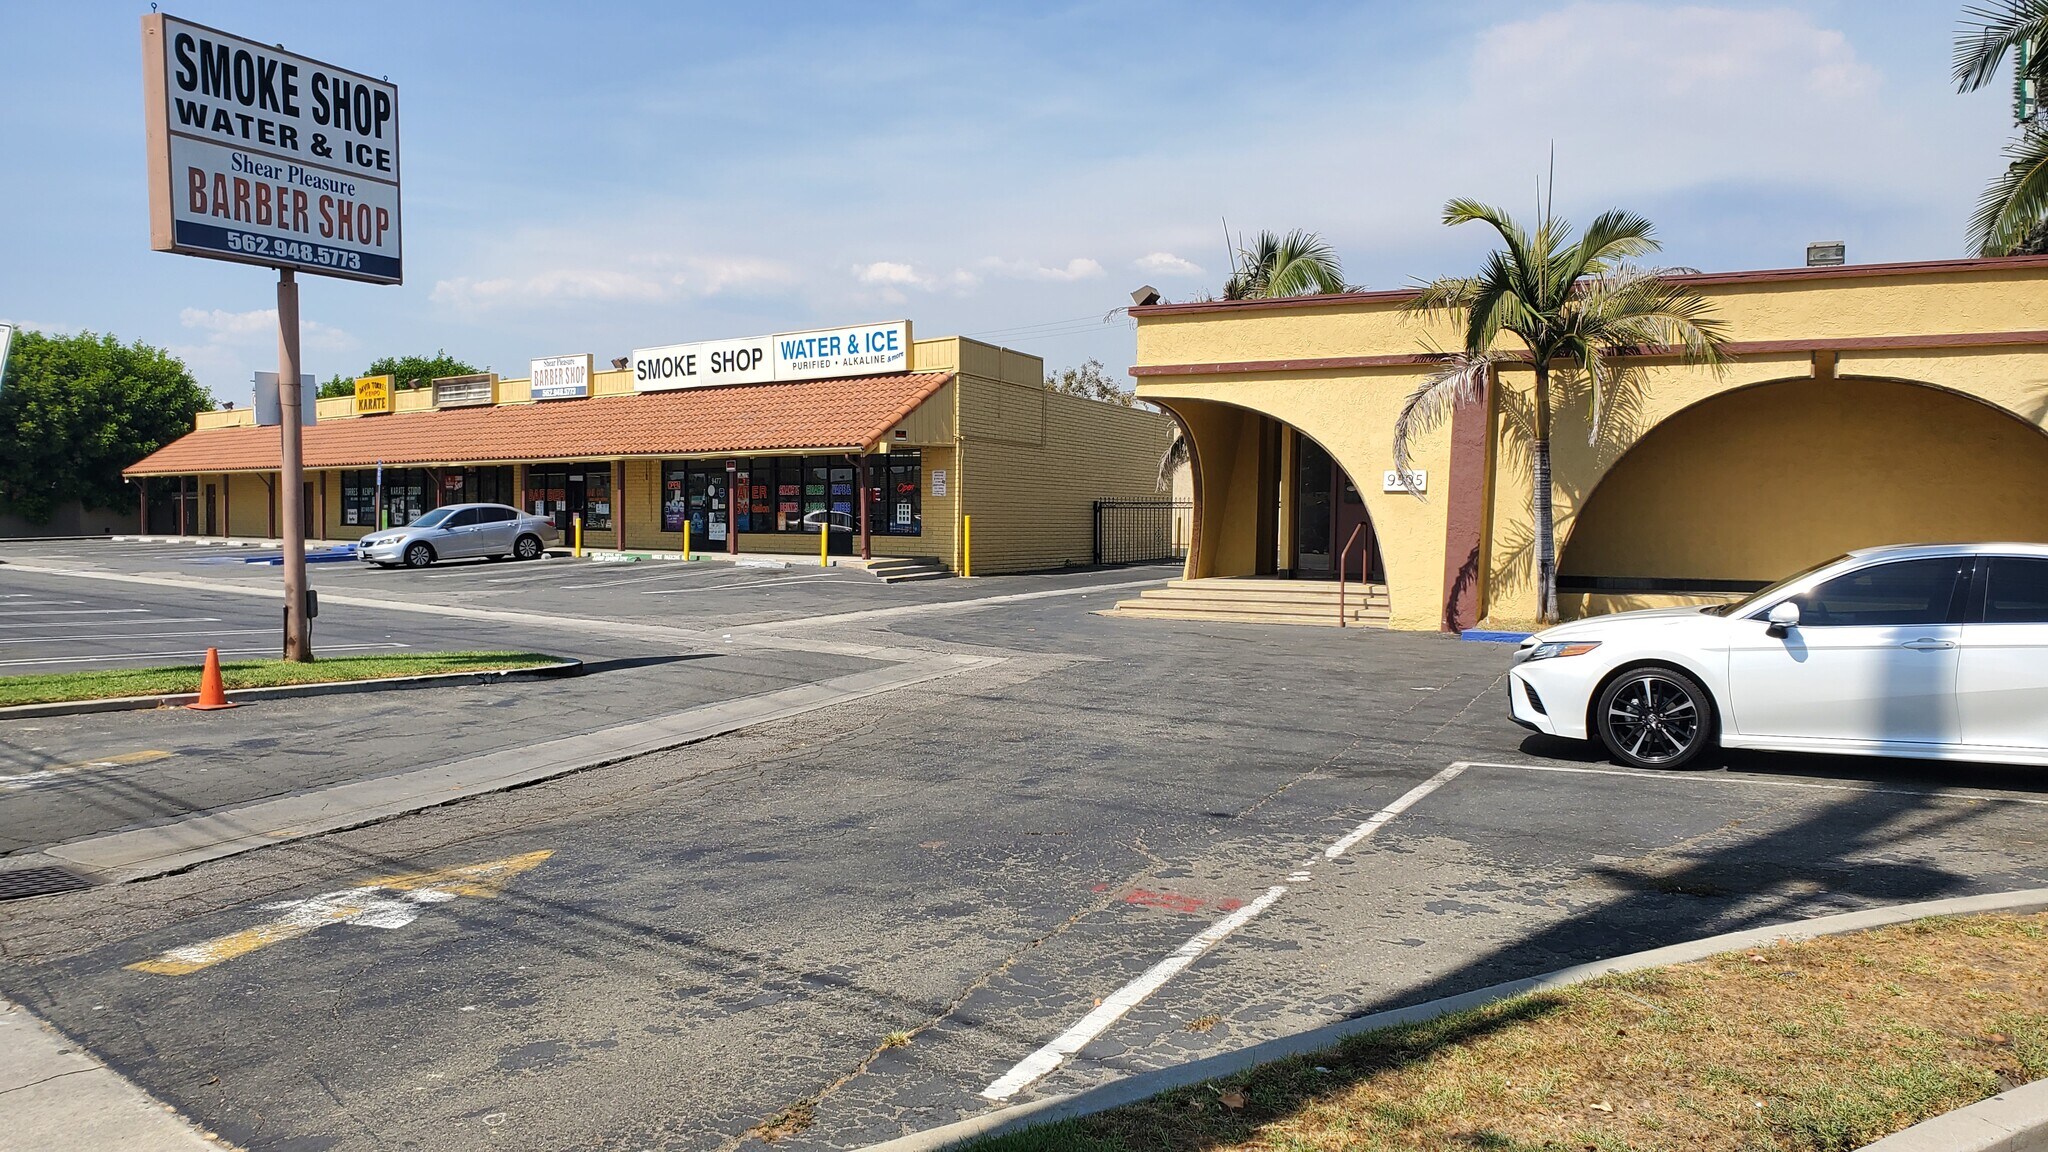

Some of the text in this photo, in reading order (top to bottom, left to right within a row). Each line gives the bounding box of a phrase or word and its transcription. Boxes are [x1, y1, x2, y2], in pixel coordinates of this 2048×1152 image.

[174, 33, 391, 139] SMOKE SHOP
[174, 97, 391, 172] WATER & ICE
[231, 152, 356, 197] Shear Pleasure
[188, 166, 389, 247] BARBER SHOP
[227, 232, 361, 270] 562.948.5773
[780, 329, 899, 361] WATER & ICE
[534, 365, 586, 387] BARBER SHOP
[637, 347, 763, 381] SMOKE SHOP
[792, 354, 886, 371] PURIFIED ALKALINE
[358, 397, 386, 411] KARATE
[390, 486, 405, 495] KARATE
[407, 486, 422, 495] STUDIO
